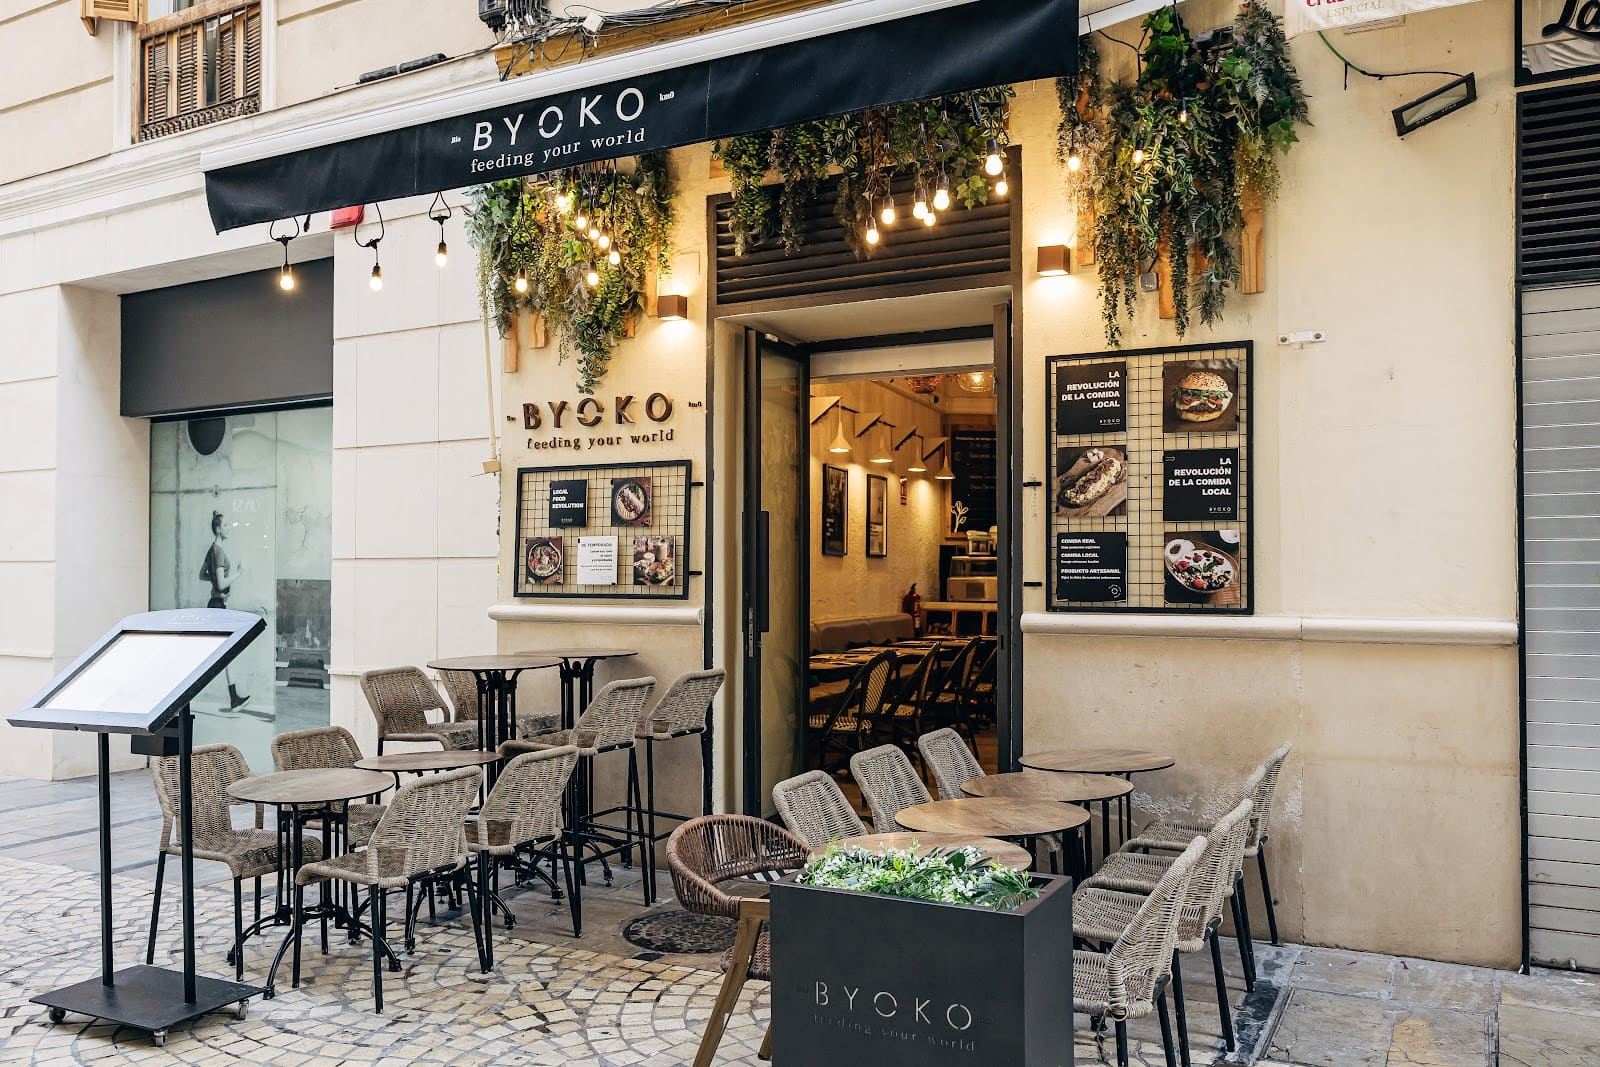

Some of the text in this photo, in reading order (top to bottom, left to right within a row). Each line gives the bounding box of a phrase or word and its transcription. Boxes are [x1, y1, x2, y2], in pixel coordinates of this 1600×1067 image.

[473, 87, 645, 151] BYOKO
[470, 127, 645, 174] feeding your world
[1108, 370, 1120, 379] LA
[1066, 379, 1120, 391] REVOLUCIÓN
[1061, 393, 1073, 401] DE
[1086, 390, 1120, 399] COMIDA
[1092, 400, 1120, 409] LOCAL
[522, 392, 674, 430] BYOKO
[527, 428, 675, 450] feeding your world
[1219, 457, 1232, 465] LA
[1173, 466, 1232, 477] REVOLUCIÓN
[1182, 478, 1194, 486] LA
[1195, 477, 1232, 486] COMIDA
[1201, 488, 1232, 496] LOCAL
[815, 980, 973, 1031] BYOKO
